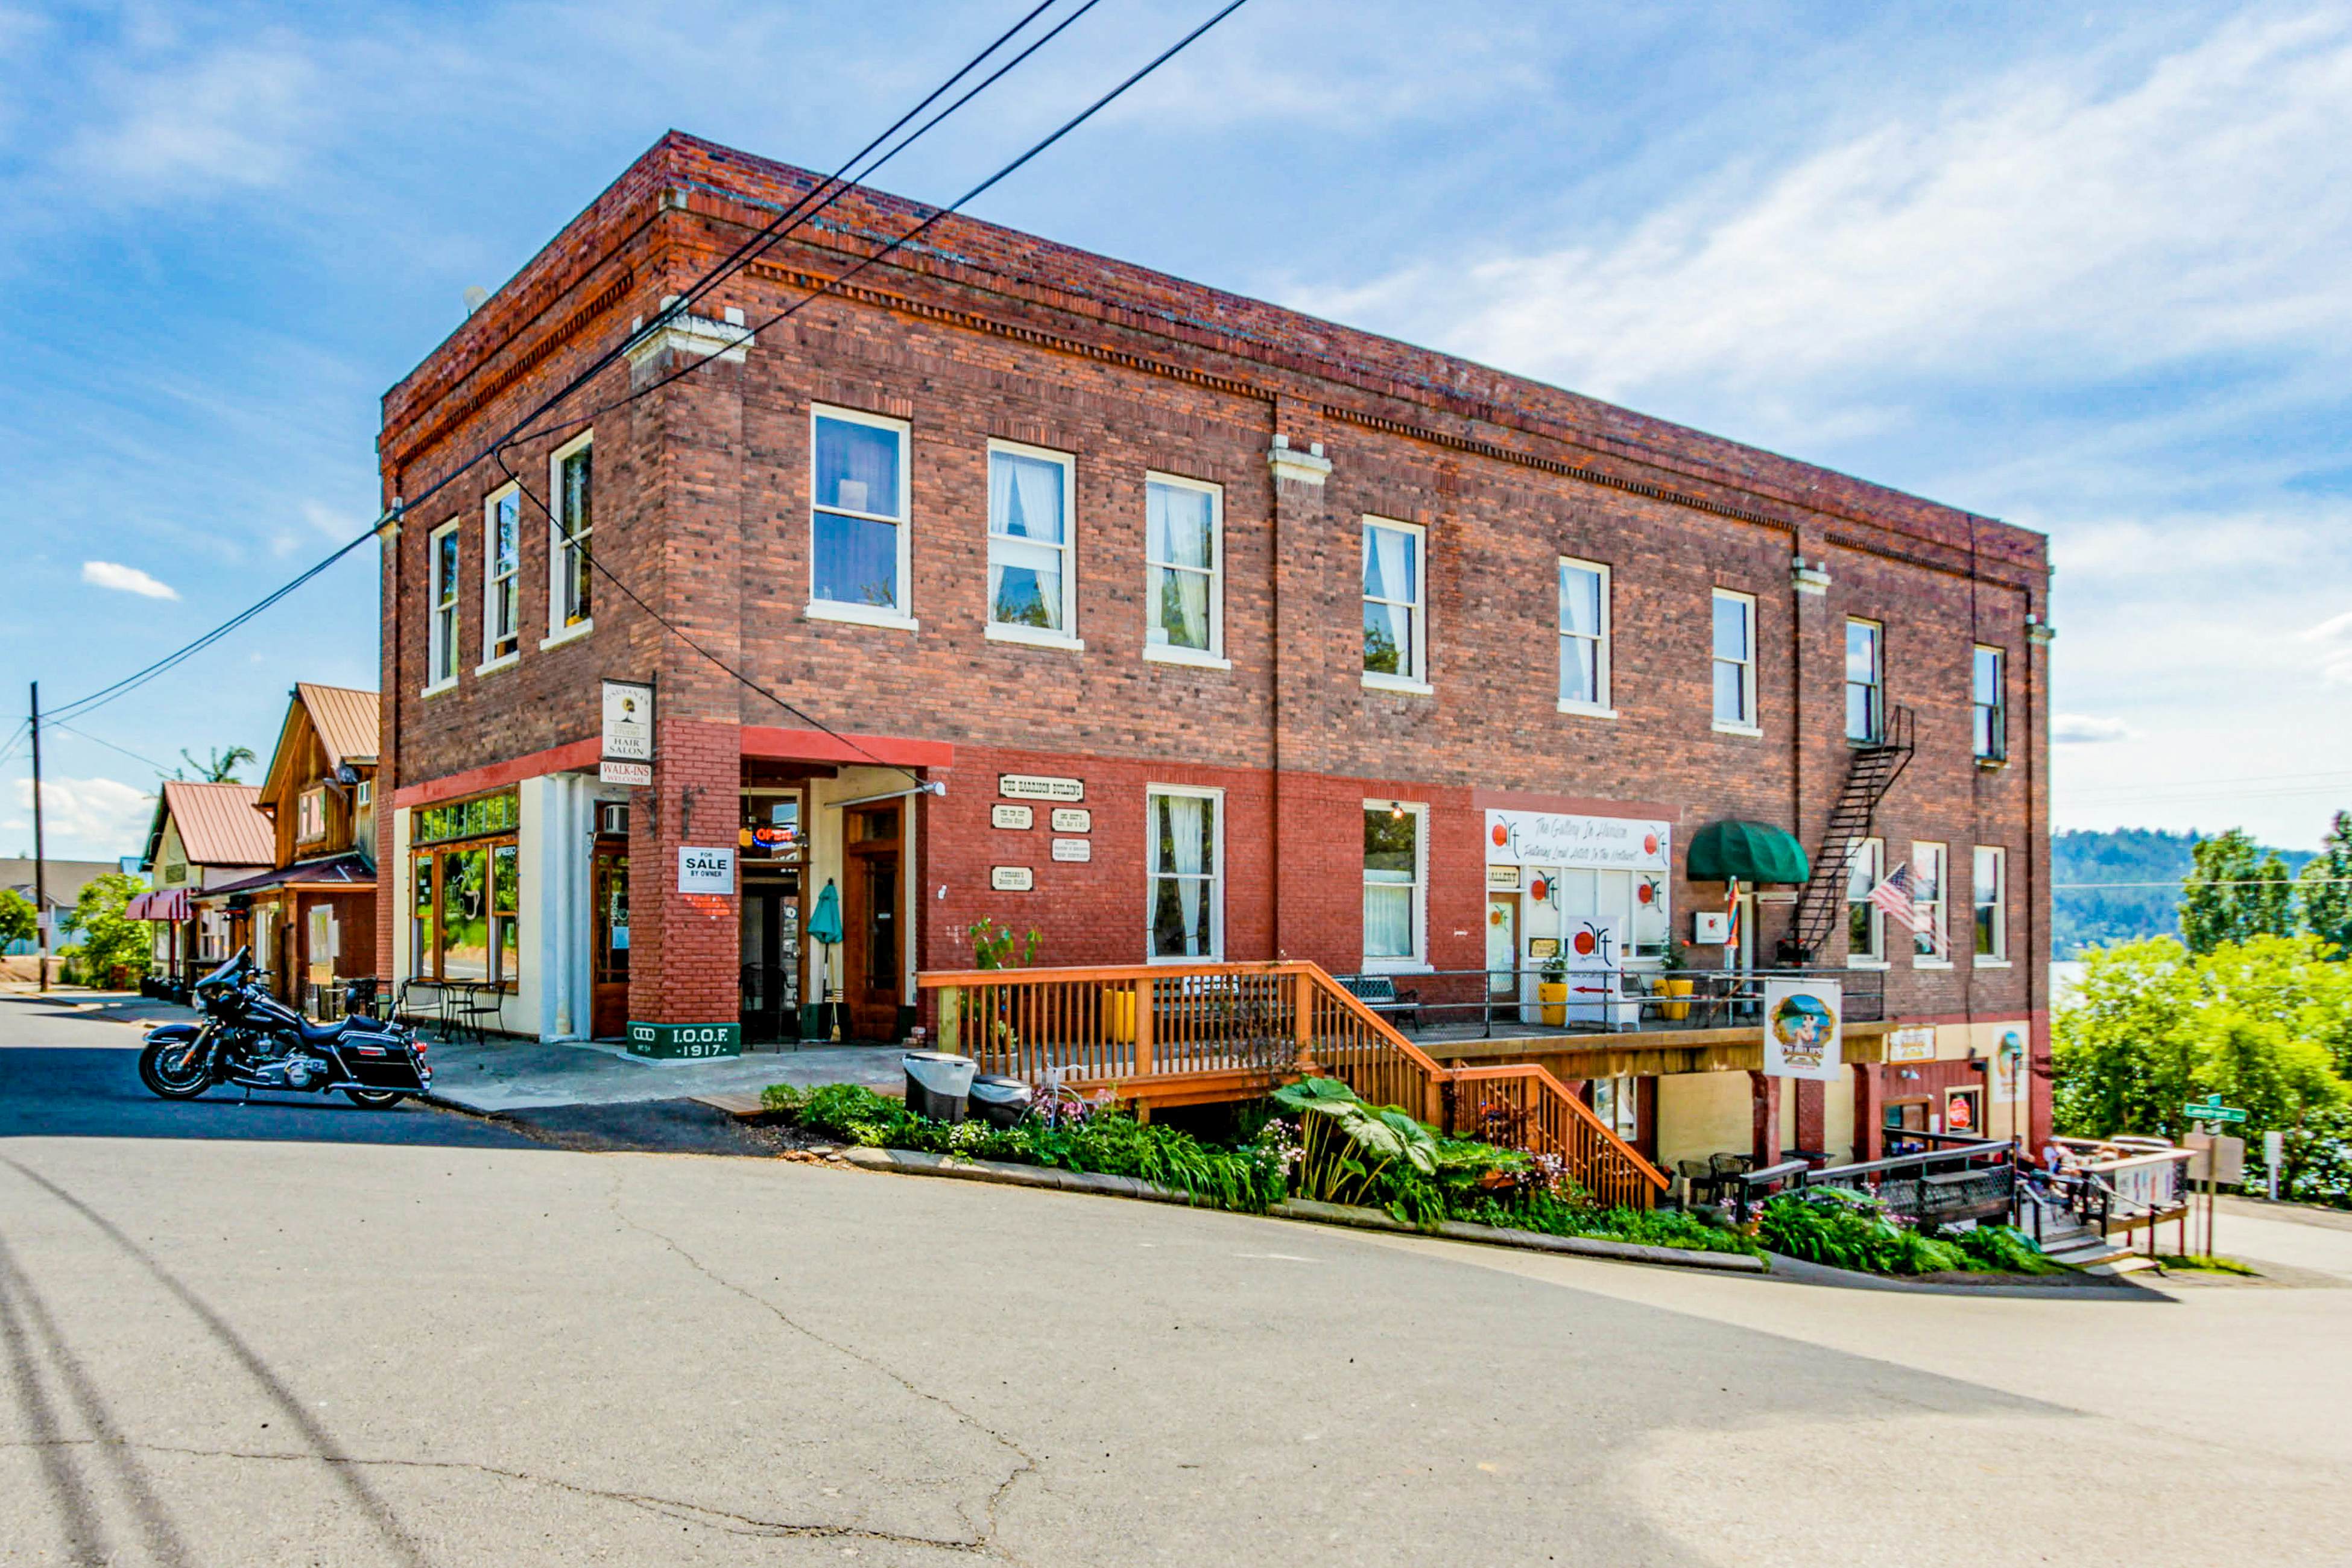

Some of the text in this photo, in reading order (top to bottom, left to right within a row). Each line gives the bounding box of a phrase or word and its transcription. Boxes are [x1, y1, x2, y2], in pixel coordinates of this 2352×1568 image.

[614, 738, 639, 747] HAIR
[609, 746, 643, 755] SALON
[603, 763, 649, 776] WALK-INS
[756, 828, 792, 841] OPEN
[686, 858, 727, 870] SALE
